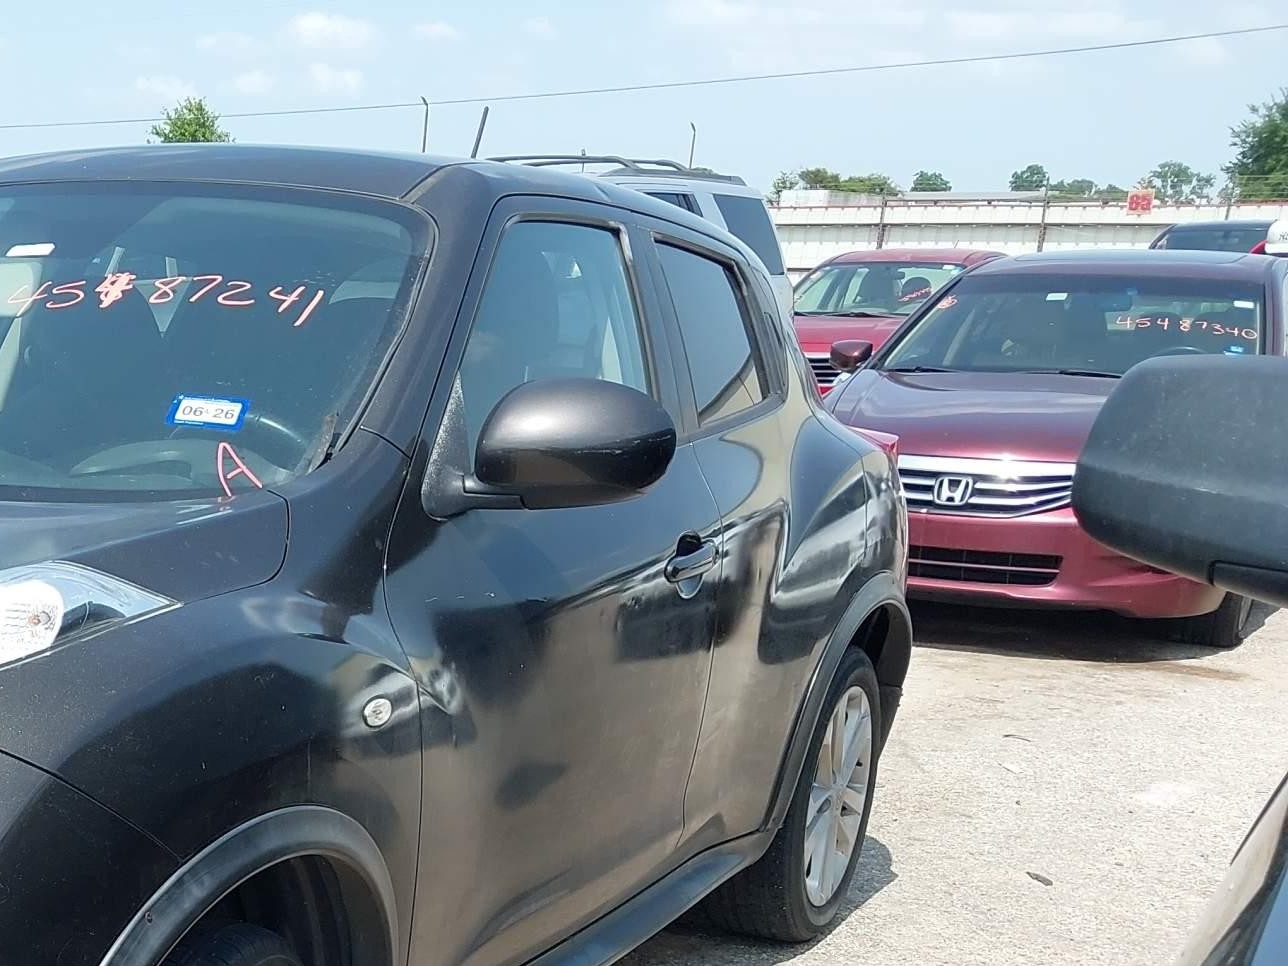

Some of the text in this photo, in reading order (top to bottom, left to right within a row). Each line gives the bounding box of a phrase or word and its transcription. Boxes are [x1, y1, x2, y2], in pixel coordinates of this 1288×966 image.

[1115, 316, 1258, 340] 45487340
[182, 405, 235, 420] 06 26
[217, 442, 263, 497] A
